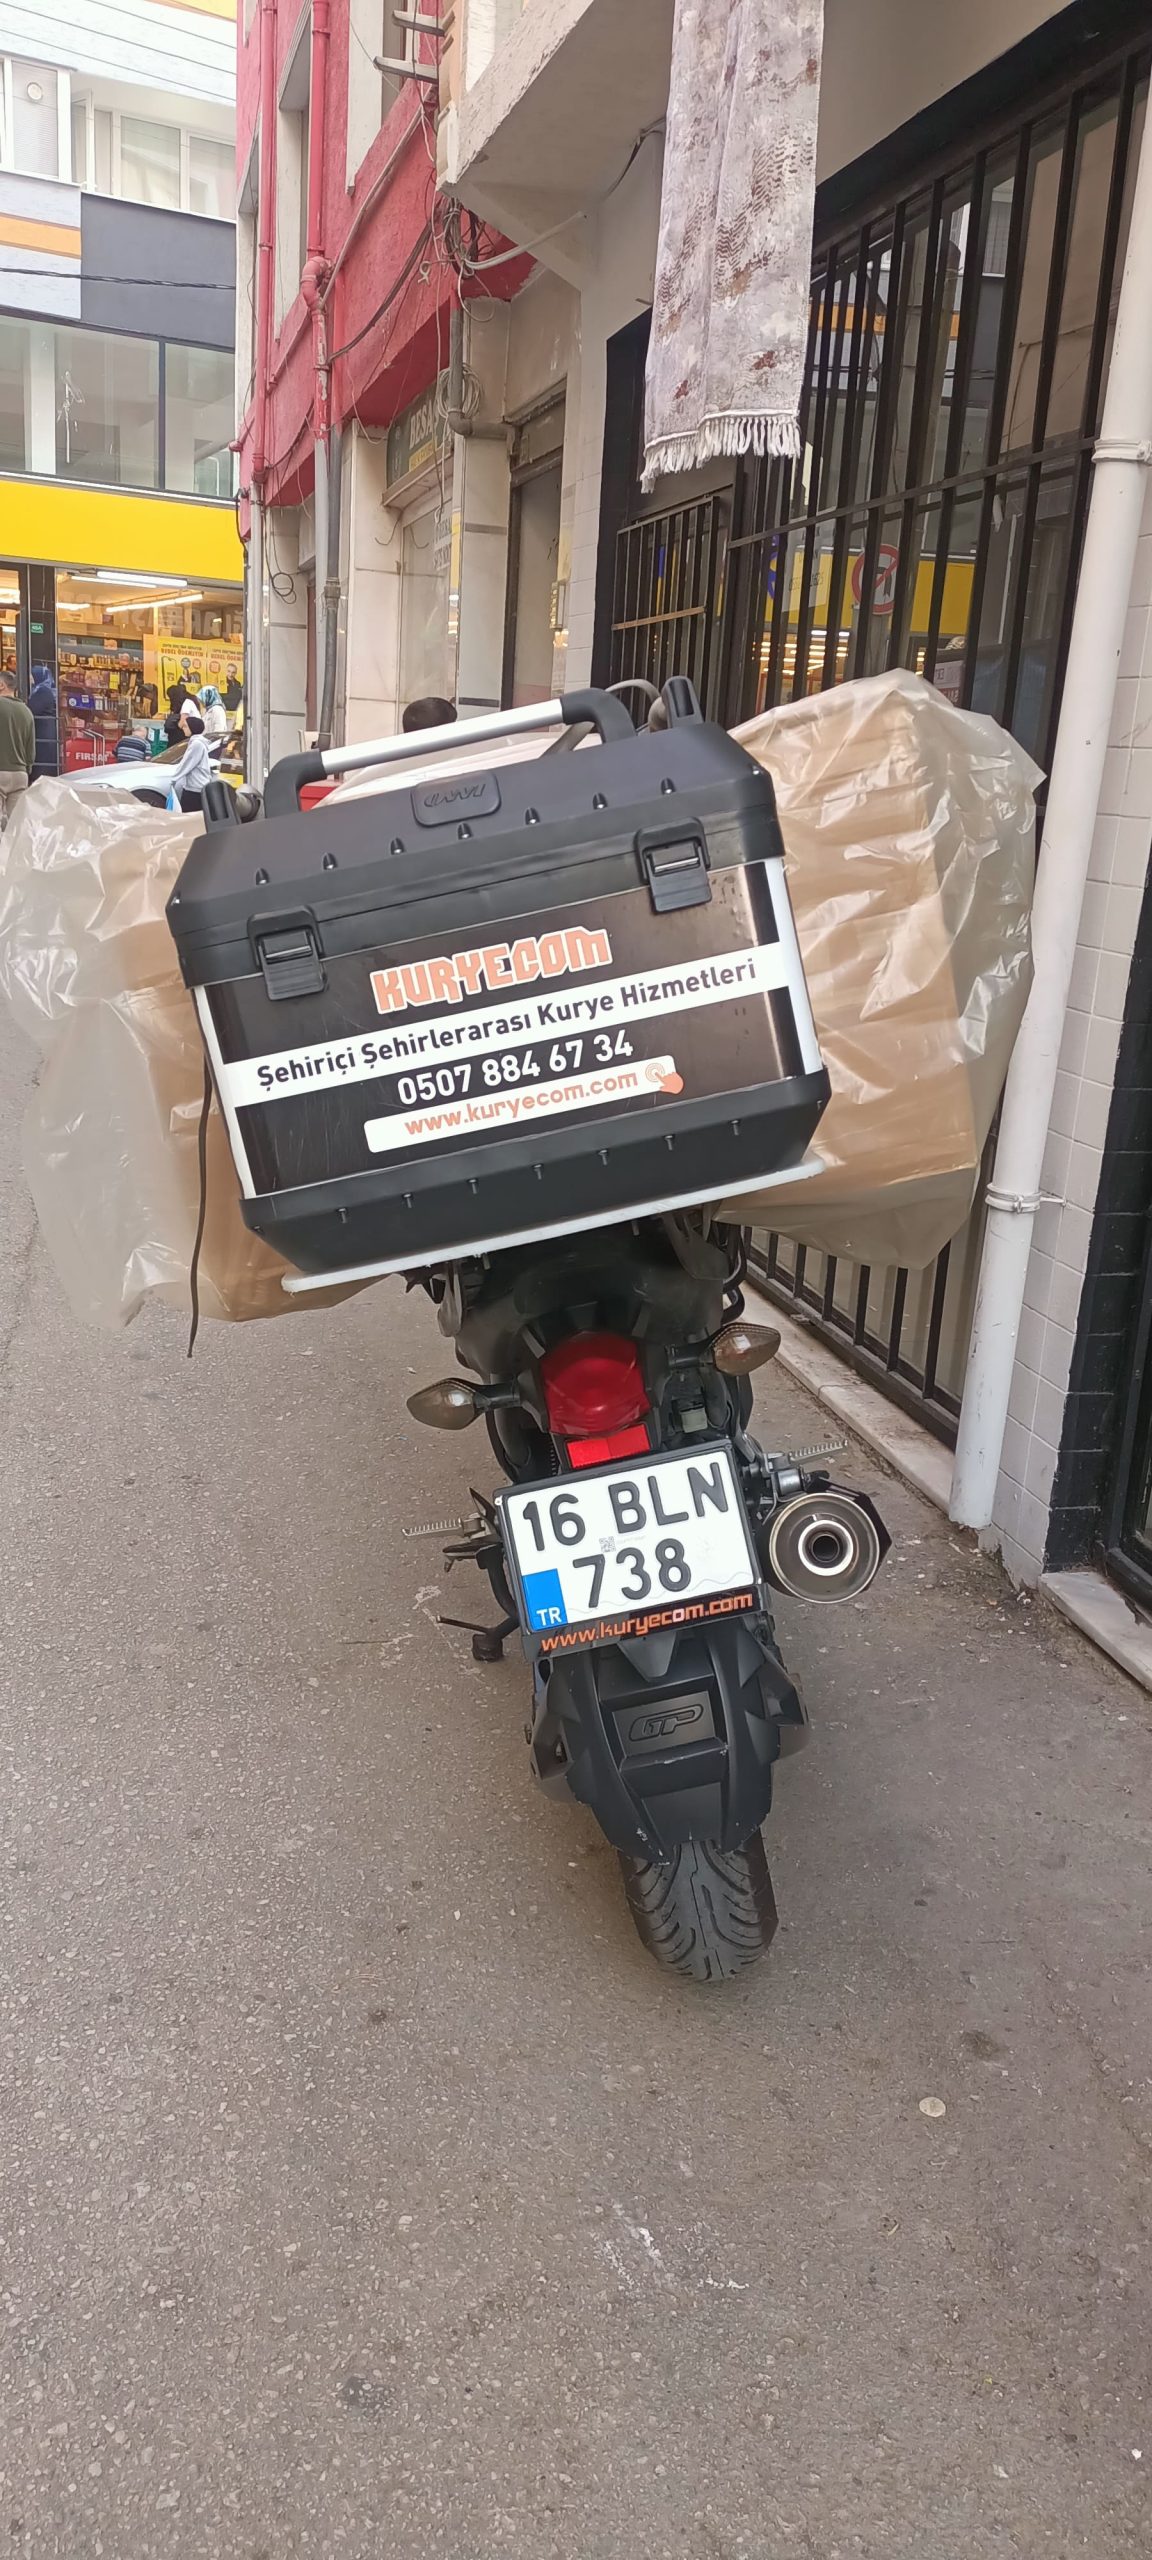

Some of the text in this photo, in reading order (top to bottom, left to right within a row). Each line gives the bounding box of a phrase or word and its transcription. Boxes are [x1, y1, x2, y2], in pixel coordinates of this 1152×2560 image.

[370, 926, 612, 1015] KURYECOM
[257, 957, 757, 1092] Şehiriçi Şehirlerarası Kurye Hizmetleri
[399, 1028, 634, 1106] 0507 884 67 34
[405, 1072, 639, 1136] www.kuryecom.com
[522, 1461, 729, 1552] 16 BLN
[572, 1538, 691, 1609] 738
[536, 1608, 562, 1628] TR
[541, 1592, 753, 1653] www.kuryecom.com
